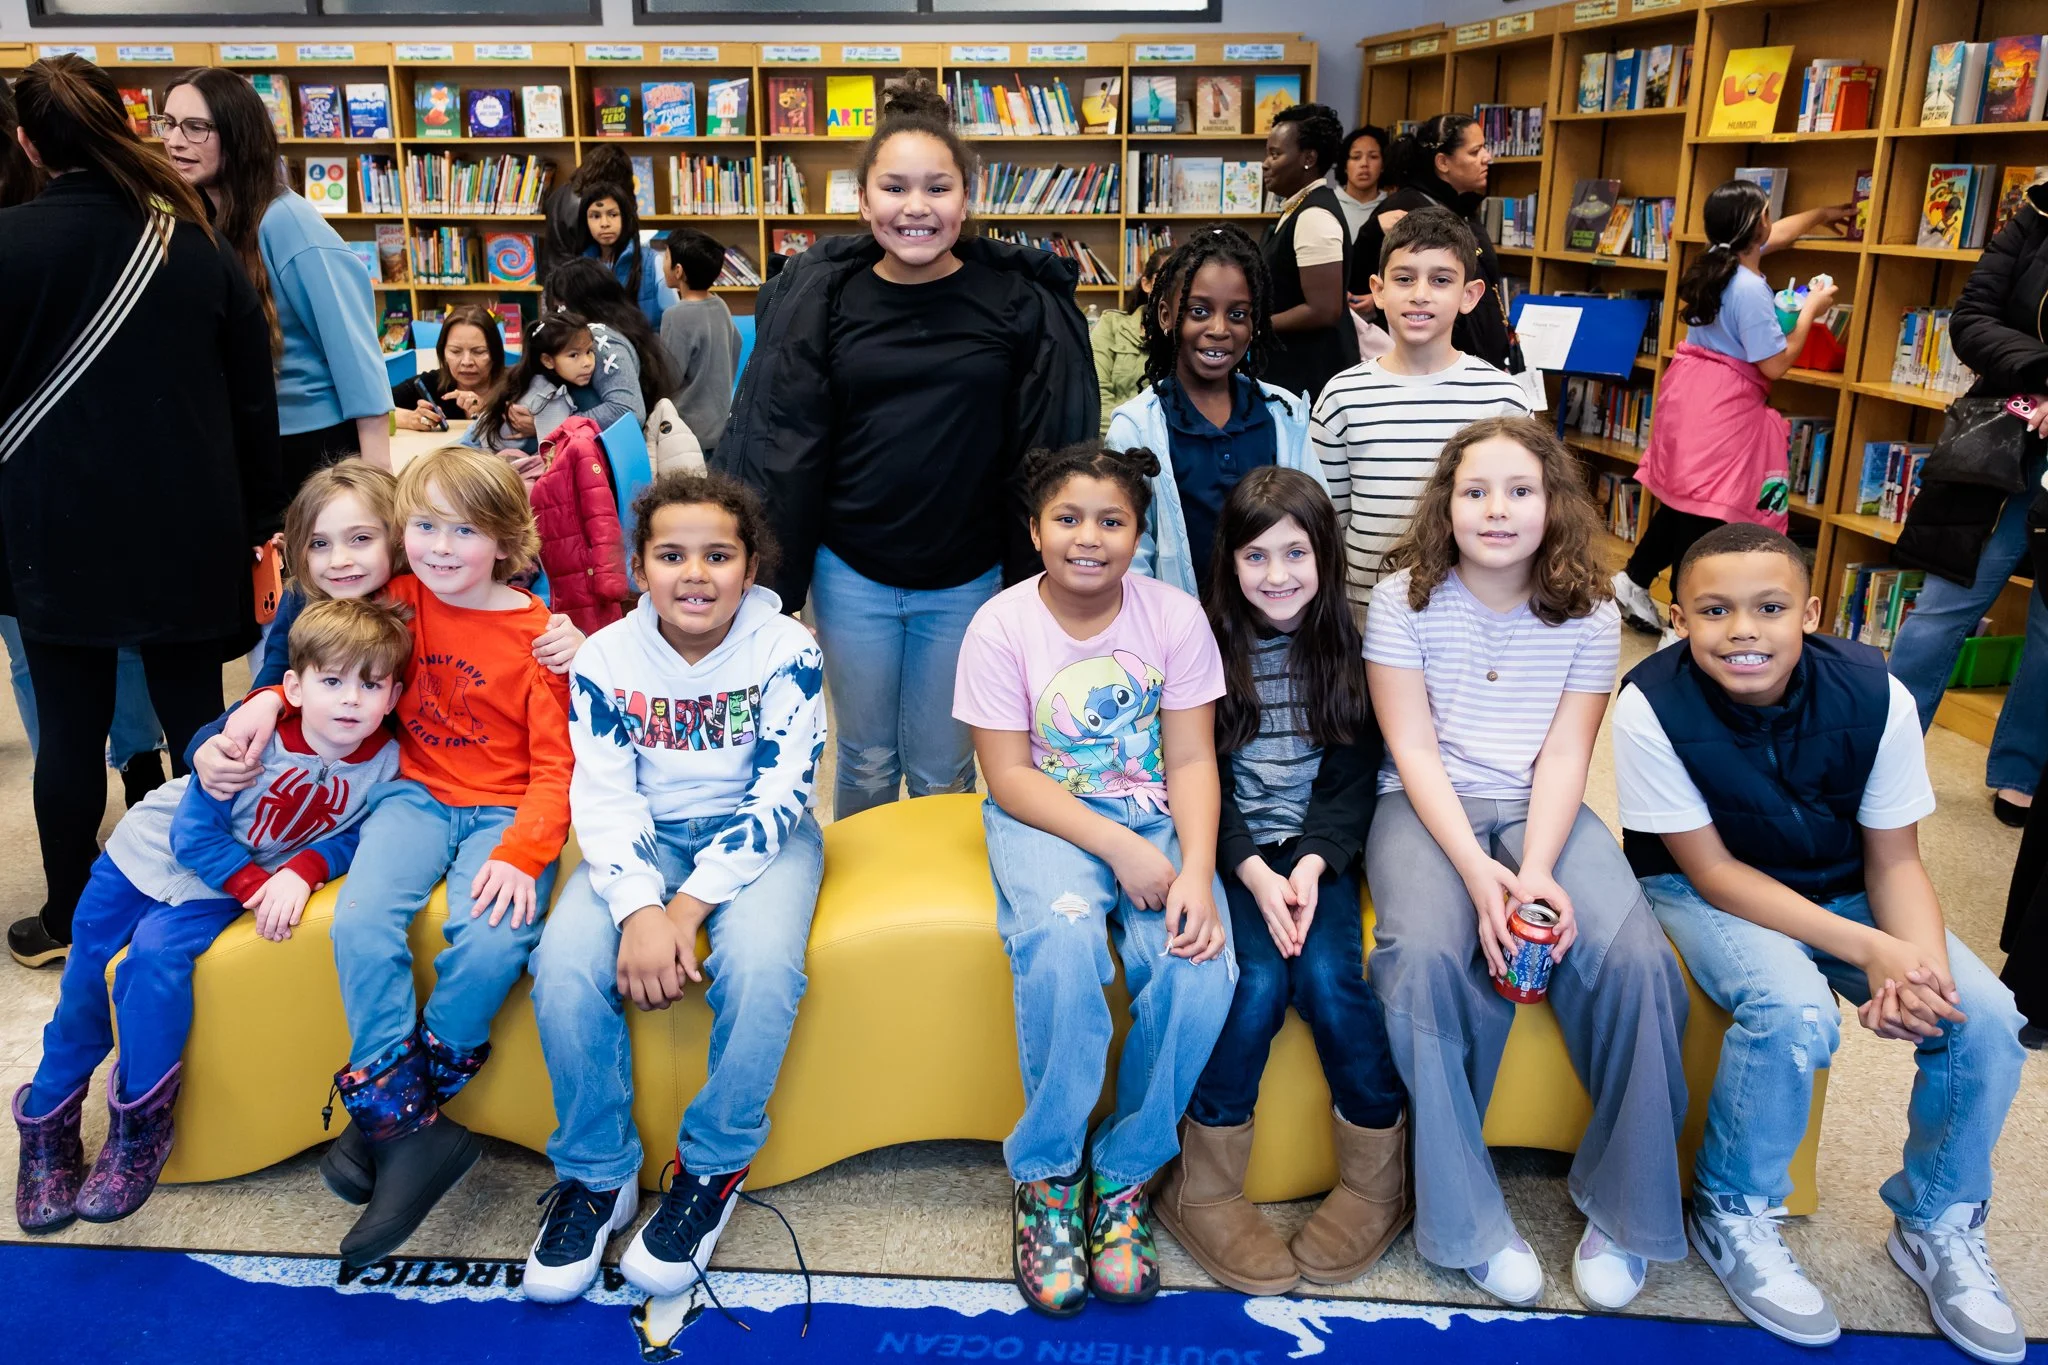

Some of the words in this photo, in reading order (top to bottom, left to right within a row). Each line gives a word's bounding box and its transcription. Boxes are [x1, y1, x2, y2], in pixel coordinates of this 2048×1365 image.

[602, 113, 627, 124] ZERO
[1727, 120, 1758, 130] HUMOR
[425, 128, 453, 137] ANIMALS
[1572, 229, 1597, 238] SCIENCE
[1571, 238, 1594, 248] FICTION
[455, 659, 487, 687] HAVE
[407, 719, 440, 747] FRIES
[875, 1331, 1025, 1360] OCEAN
